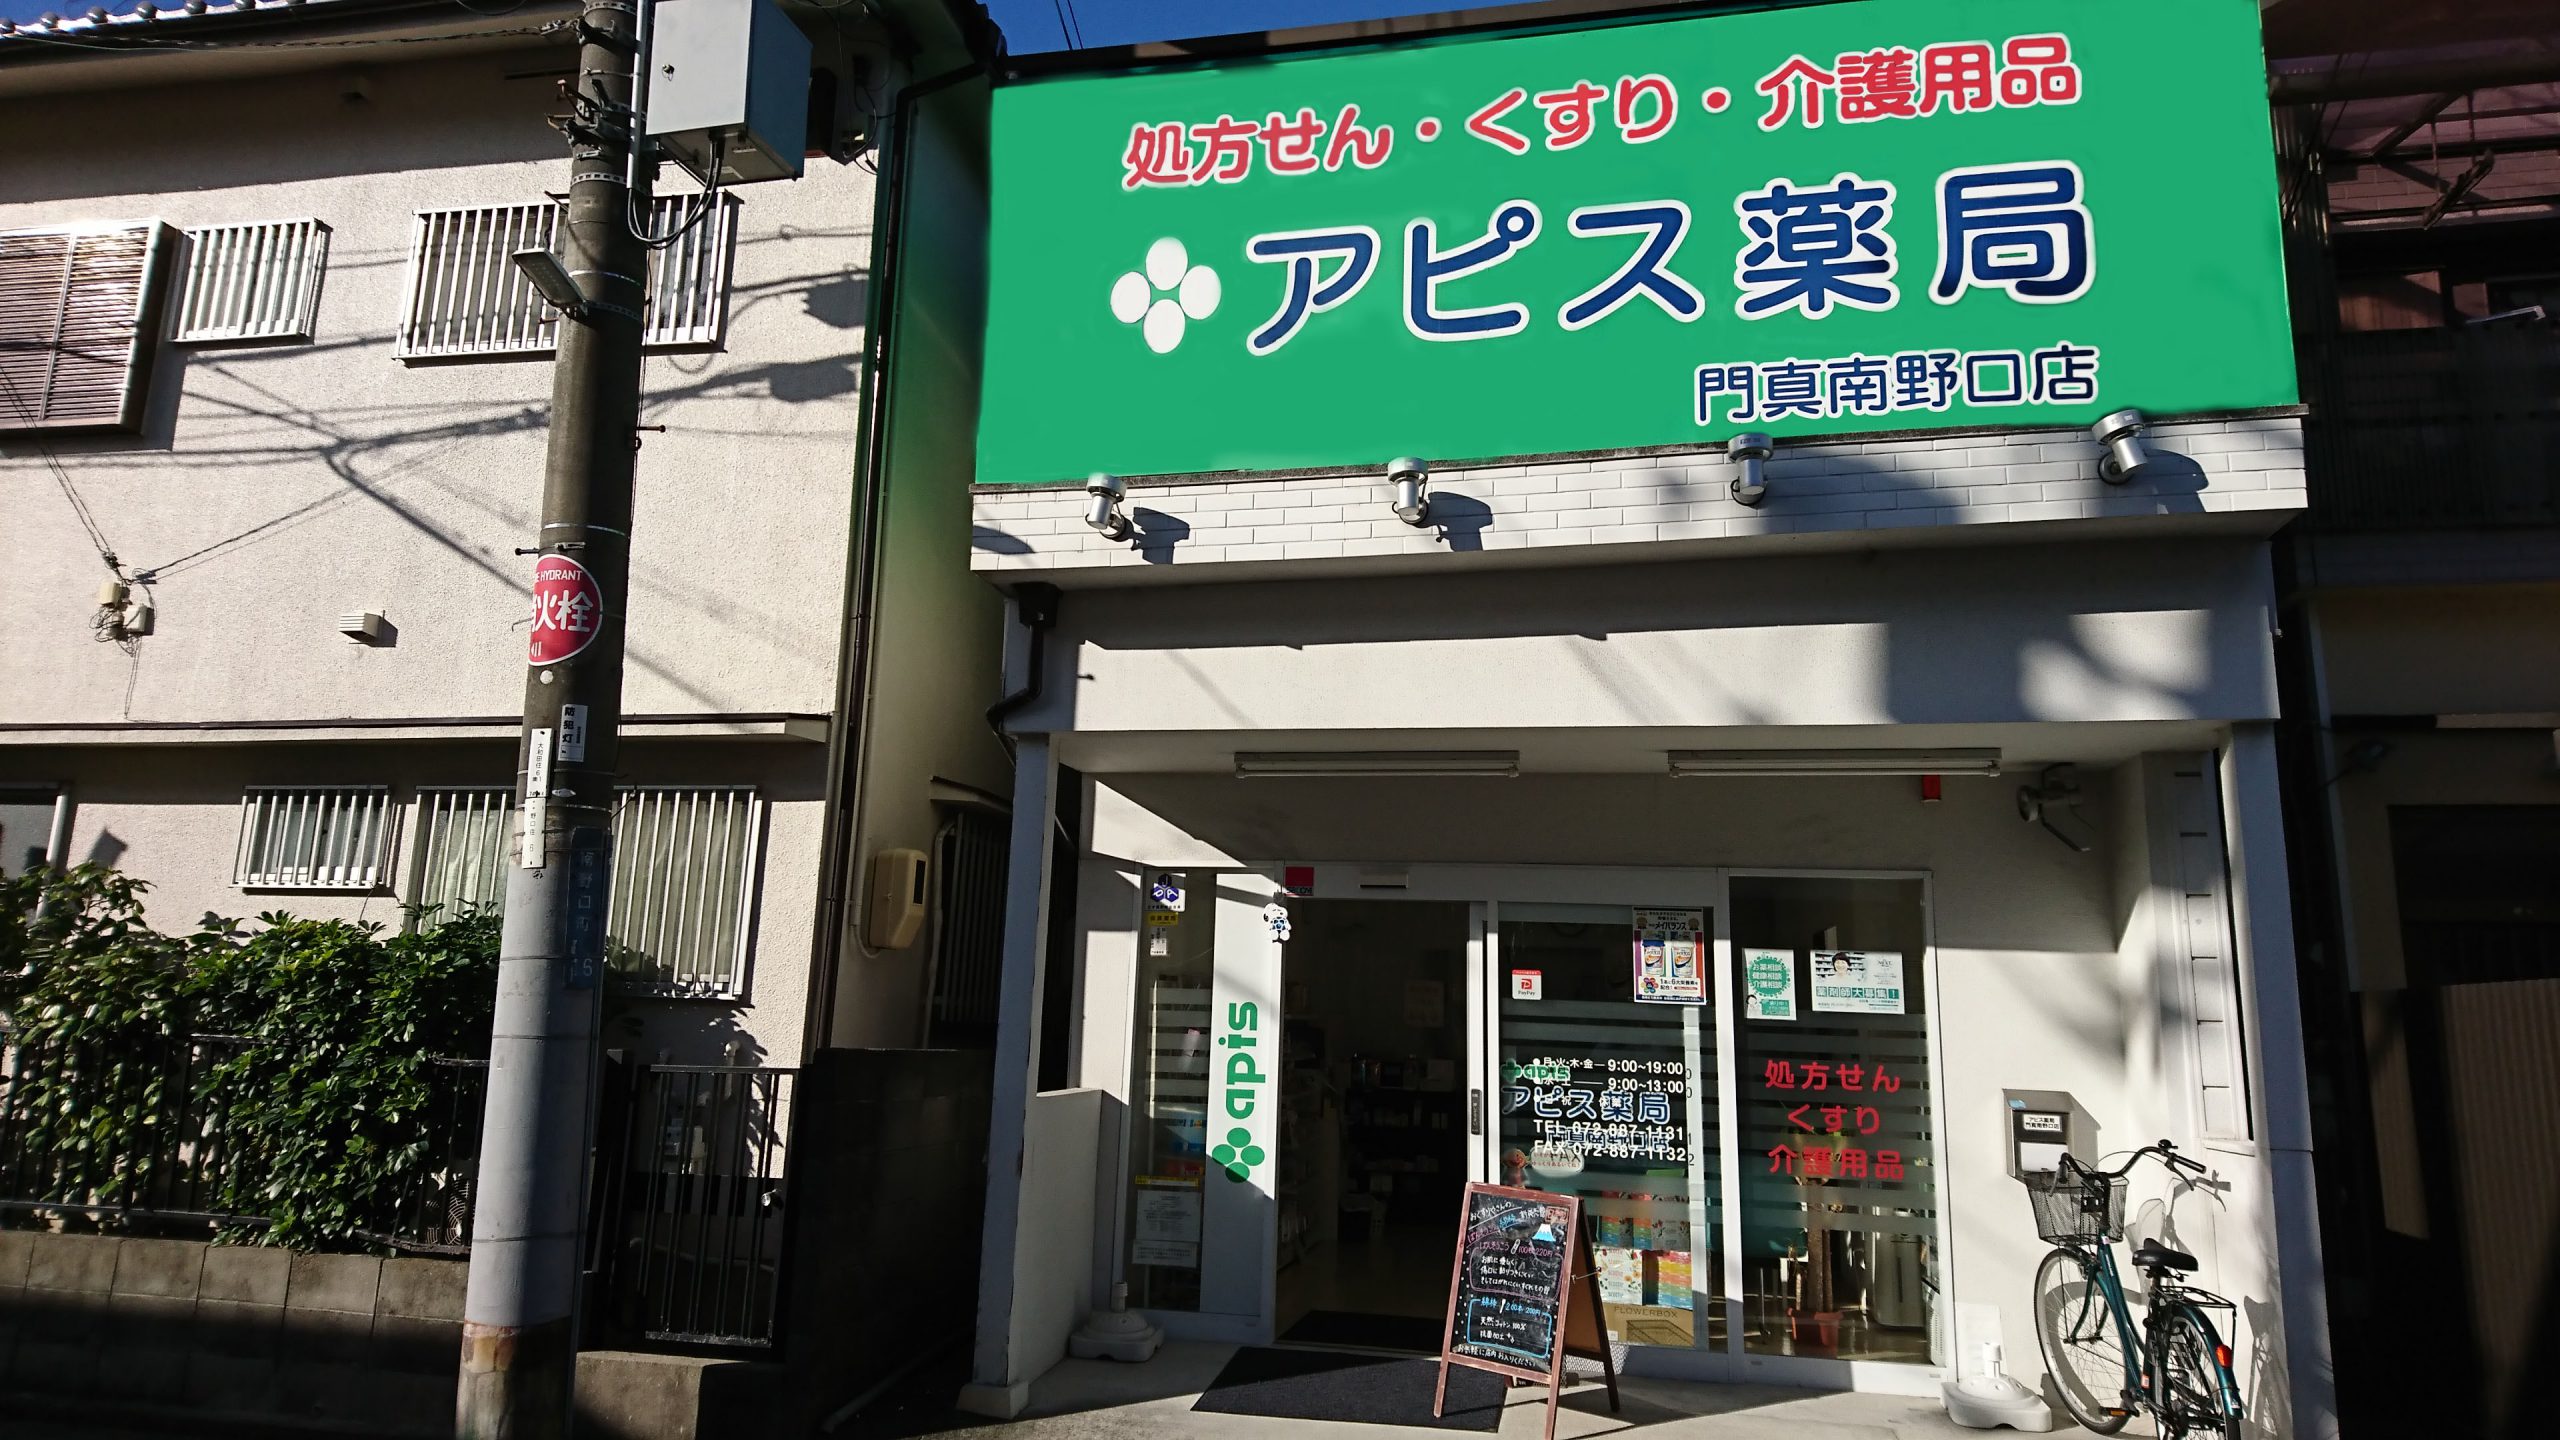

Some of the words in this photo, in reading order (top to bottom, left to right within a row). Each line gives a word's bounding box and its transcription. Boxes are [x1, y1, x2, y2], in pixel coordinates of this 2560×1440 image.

[1246, 159, 2094, 356] アピス薬局
[1694, 341, 2099, 425] 門真南野口店
[541, 569, 583, 581] HYDRANT
[562, 706, 576, 744] 防犯灯
[1218, 1001, 1266, 1120] apis
[1608, 1059, 1684, 1075] 9:00~19:00
[1764, 1059, 1901, 1094] 処方せん
[1608, 1077, 1684, 1094] 9:00~13:00
[1502, 1085, 1670, 1125] アピス薬局
[1787, 1104, 1881, 1134] くすり
[1533, 1119, 1561, 1134] TEL
[1572, 1121, 1683, 1140] 072-887-1131
[1534, 1140, 1566, 1153] FAX
[1573, 1141, 1686, 1162] 072-887-1132
[1768, 1143, 1905, 1180] 介護用品
[1614, 1305, 1678, 1318] FLOWERBOX
